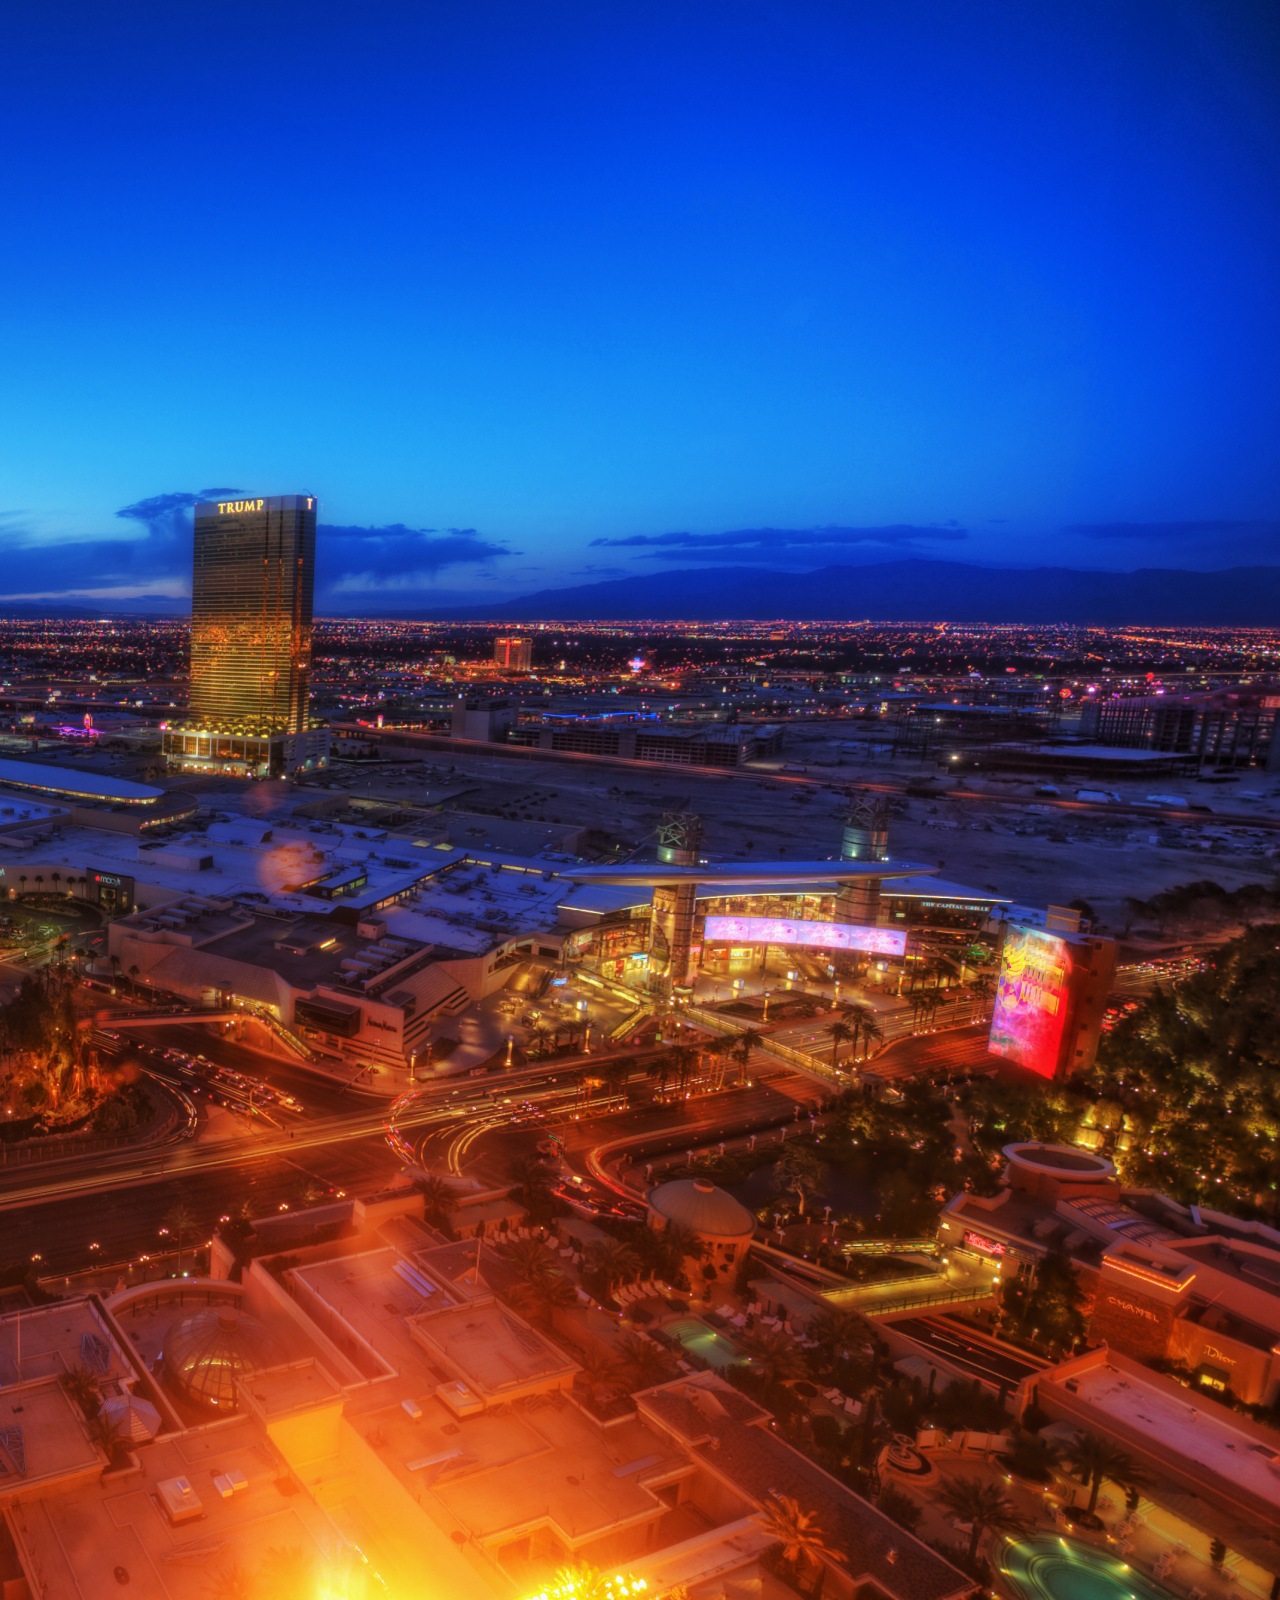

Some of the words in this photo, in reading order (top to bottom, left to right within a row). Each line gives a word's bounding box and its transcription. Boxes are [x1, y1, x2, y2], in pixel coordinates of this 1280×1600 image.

[218, 499, 264, 514] TRUMP
[1107, 1296, 1160, 1324] CHANEL
[1204, 1344, 1237, 1366] Dior
